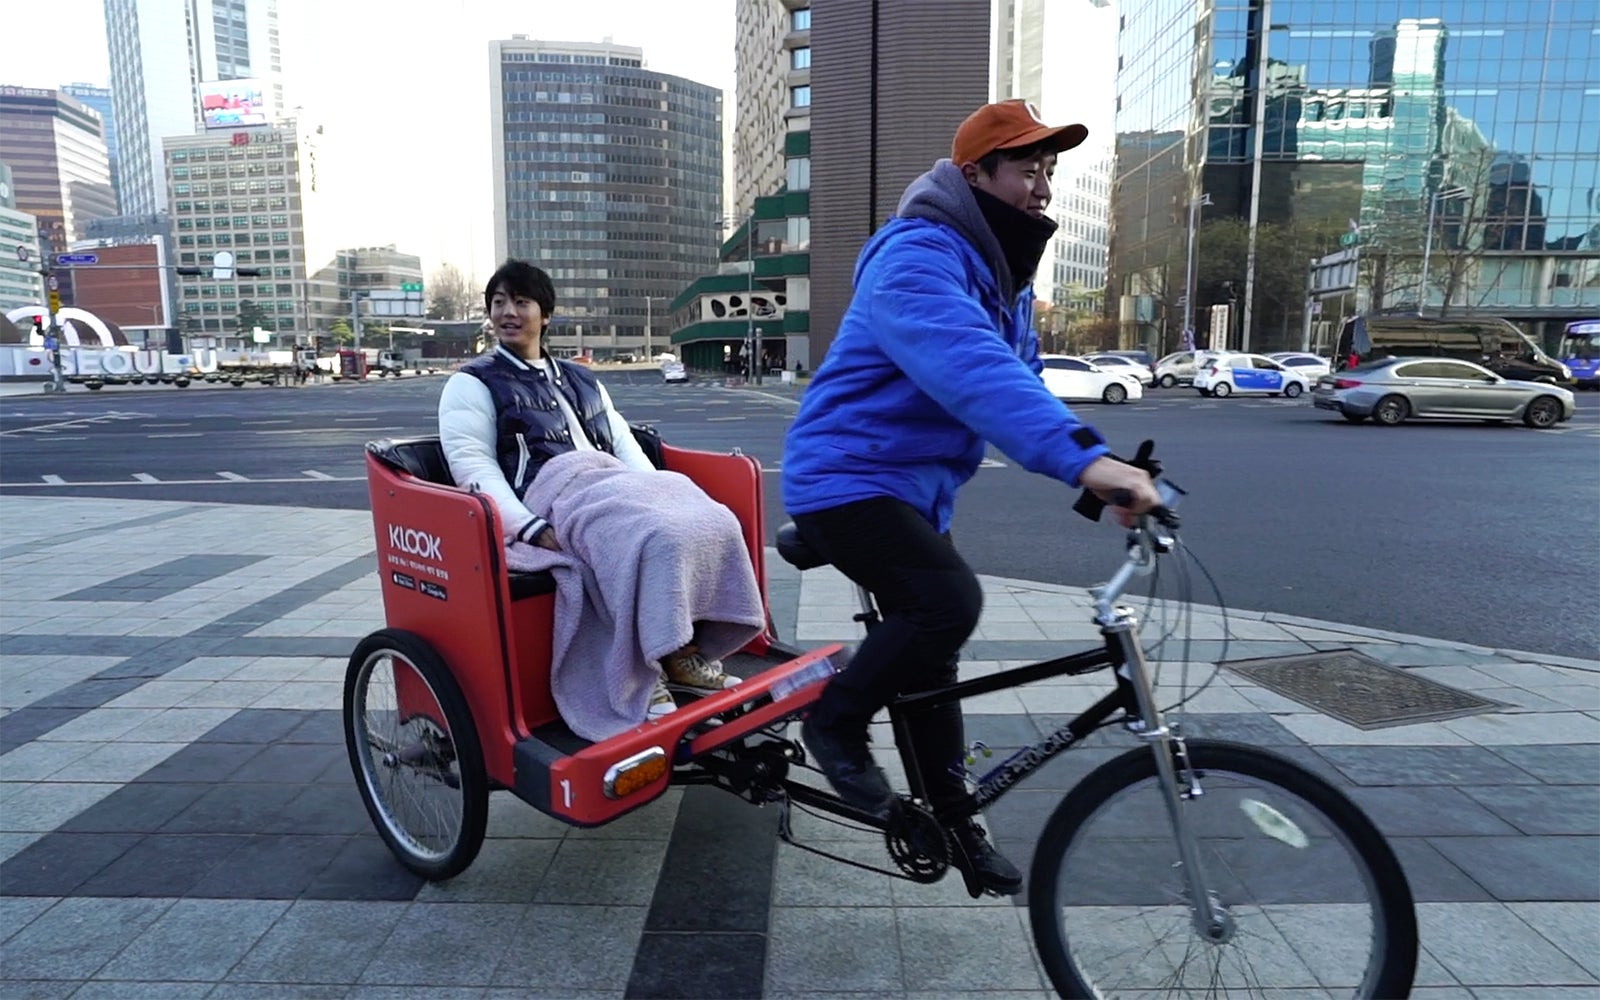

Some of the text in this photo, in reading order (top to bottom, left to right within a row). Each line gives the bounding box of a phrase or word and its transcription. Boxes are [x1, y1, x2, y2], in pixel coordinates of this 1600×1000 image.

[56, 350, 194, 375] SEOUL
[194, 349, 218, 374] U
[387, 523, 443, 562] KLOOK
[560, 779, 571, 808] 1
